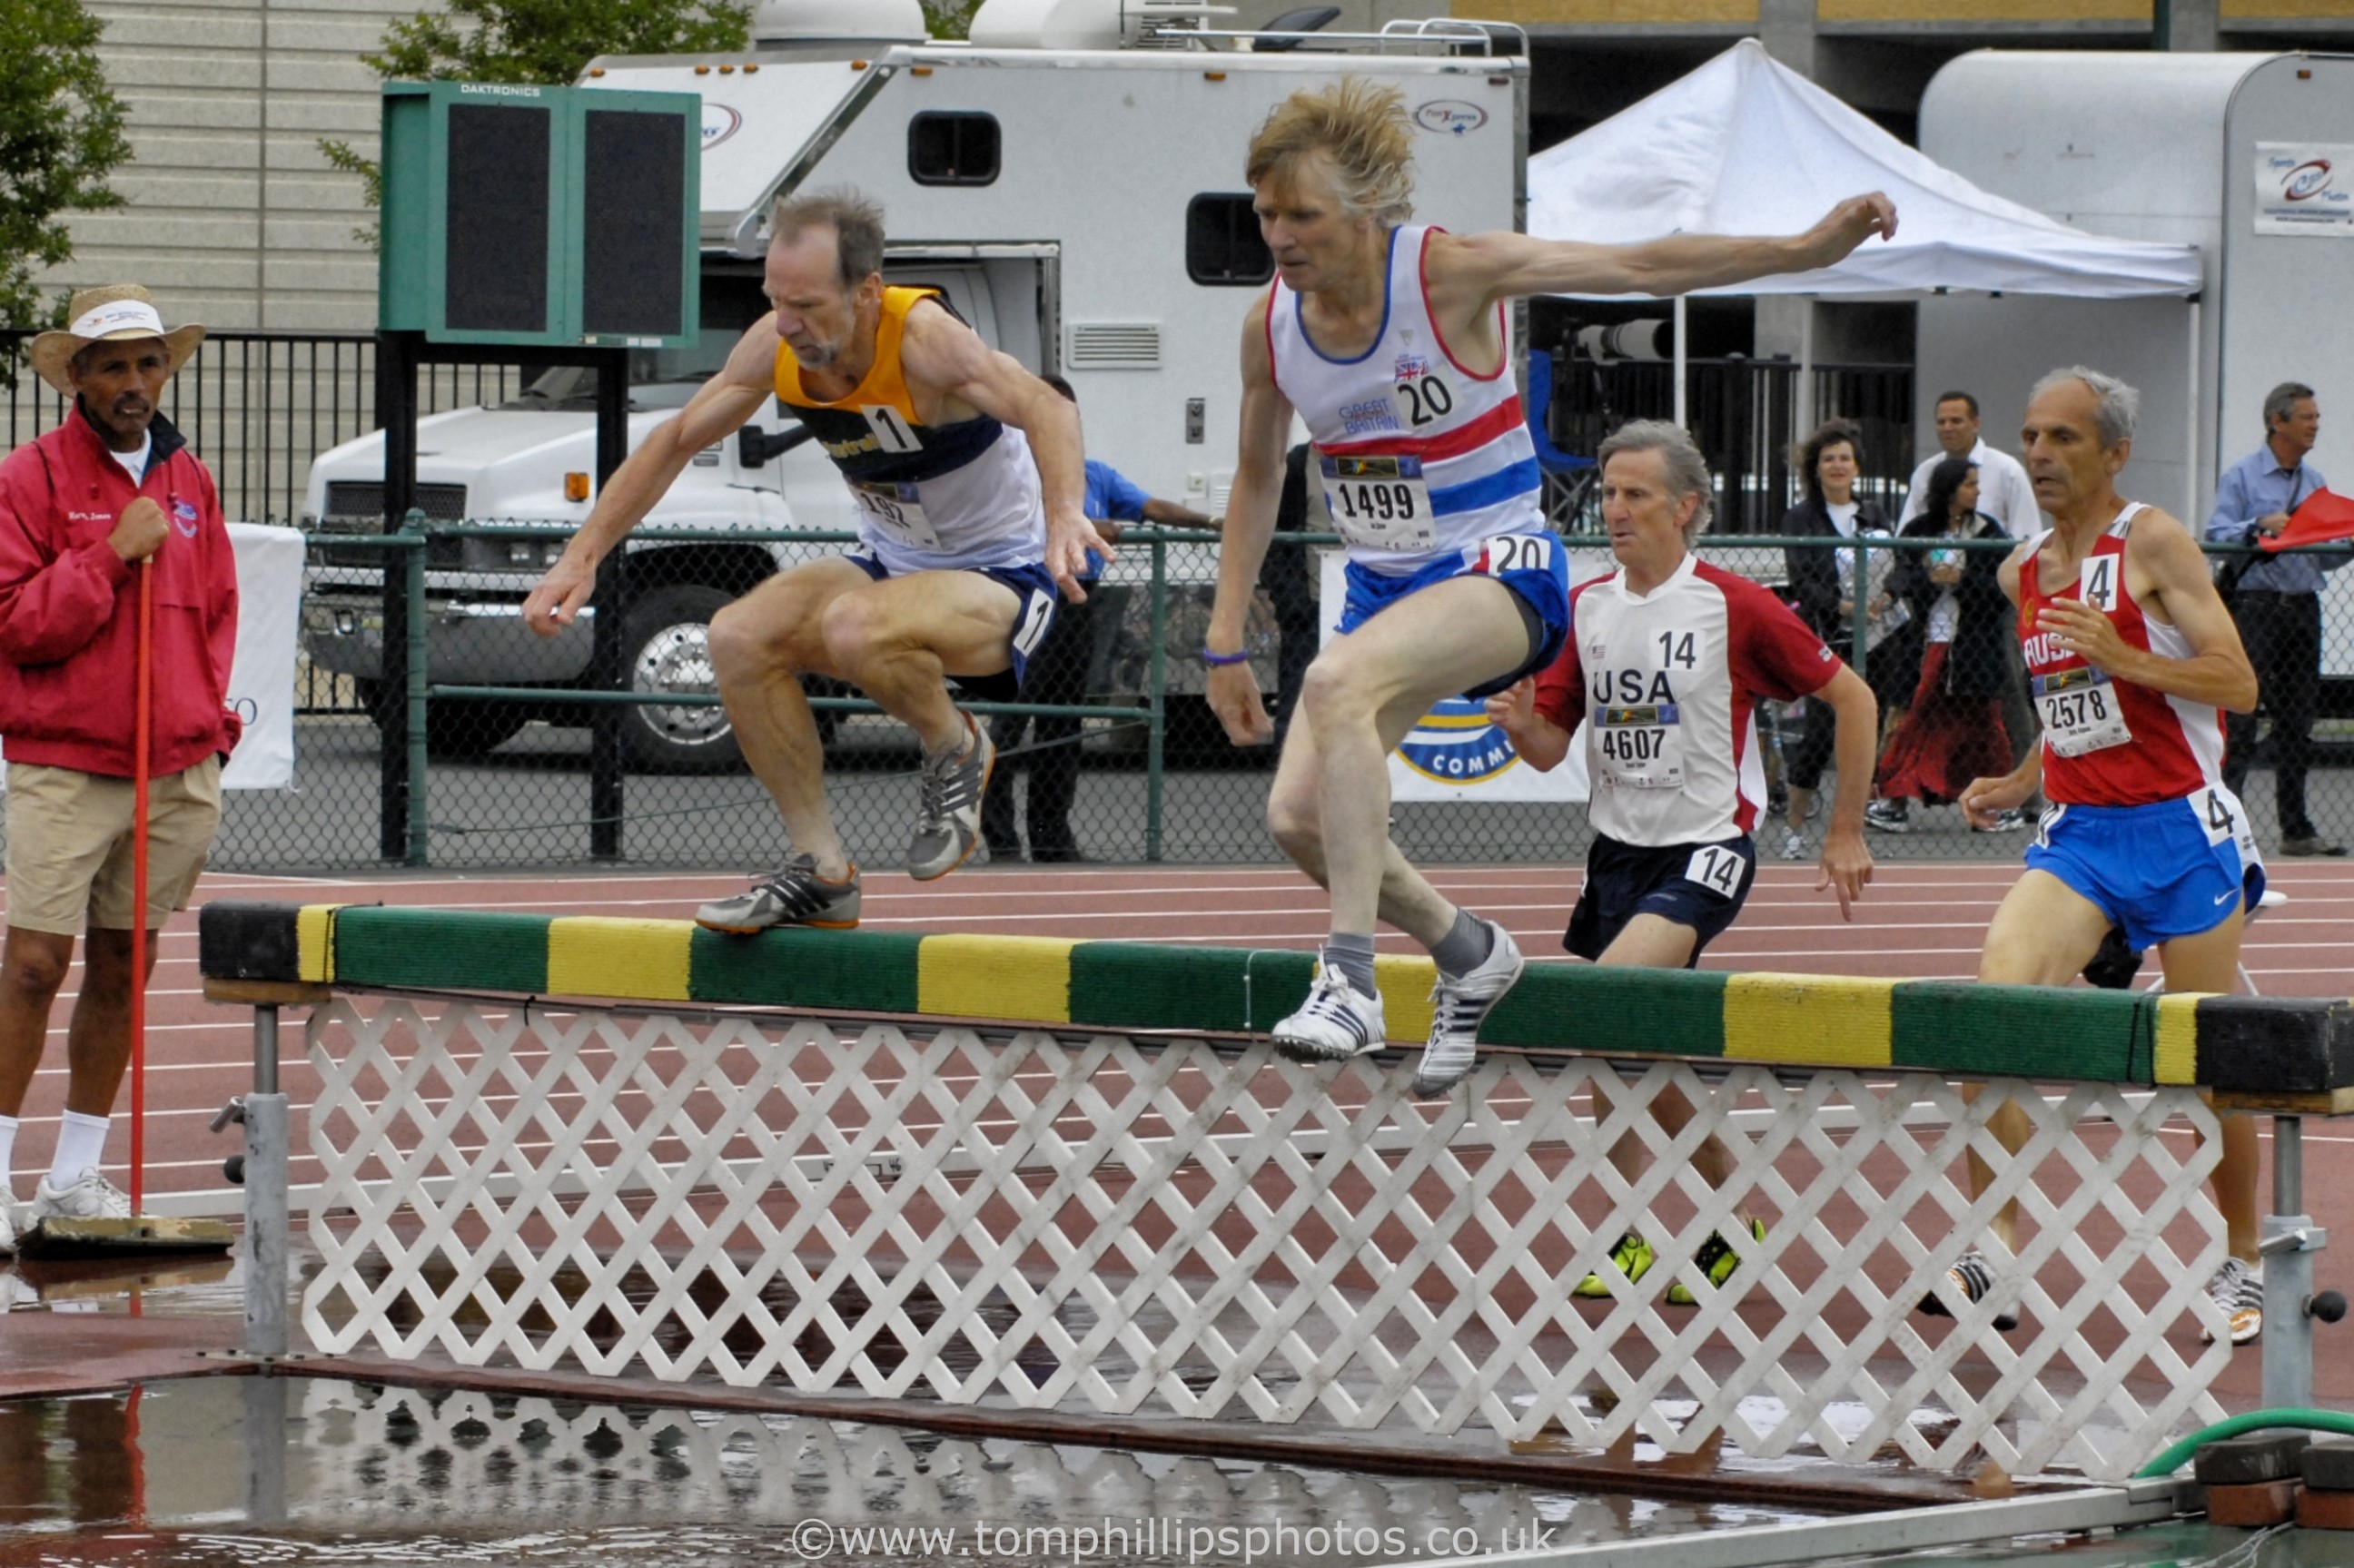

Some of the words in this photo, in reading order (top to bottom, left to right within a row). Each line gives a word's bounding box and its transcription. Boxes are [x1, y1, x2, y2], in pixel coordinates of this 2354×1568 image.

[460, 84, 540, 97] DAKTRONICS
[1339, 399, 1389, 419] GREAT
[1398, 375, 1452, 426] 20
[875, 408, 907, 449] 1
[1344, 415, 1399, 435] BRITAIN
[1339, 483, 1414, 520] 1499
[1496, 536, 1541, 574] 20
[2087, 559, 2111, 608] 4
[1023, 600, 1050, 650] 1
[1658, 630, 1696, 670] 14
[1593, 668, 1676, 705] USA
[2045, 690, 2106, 729] 2578
[1603, 729, 1666, 760] 4607
[2208, 788, 2234, 834] 4
[1702, 848, 1738, 892] 14
